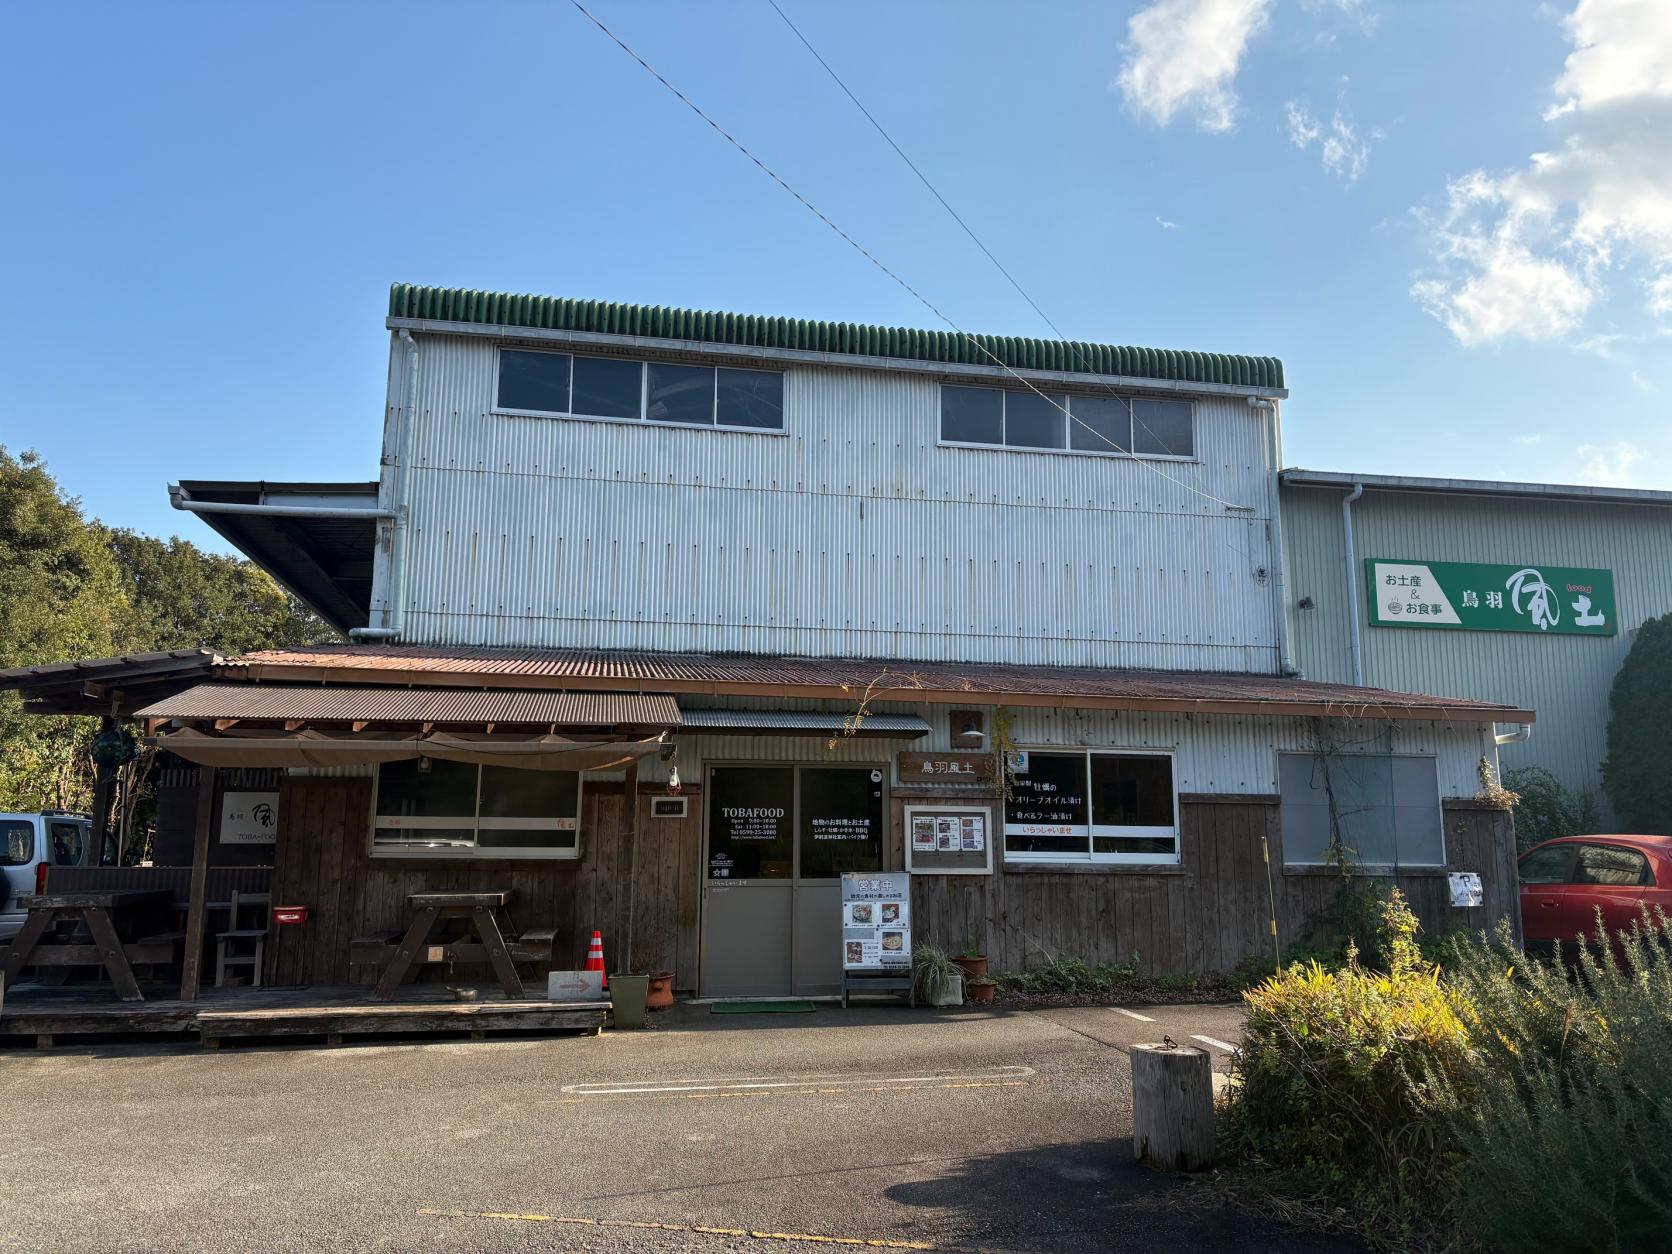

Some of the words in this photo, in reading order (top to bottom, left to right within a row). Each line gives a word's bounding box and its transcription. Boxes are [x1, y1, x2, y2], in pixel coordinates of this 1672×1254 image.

[1385, 574, 1422, 587] お土産
[1410, 588, 1421, 600] &
[1406, 602, 1442, 616] お食事
[921, 761, 975, 774] 鳥羽風土
[722, 808, 785, 818] TOBAFOOD
[858, 880, 893, 891] 営業中
